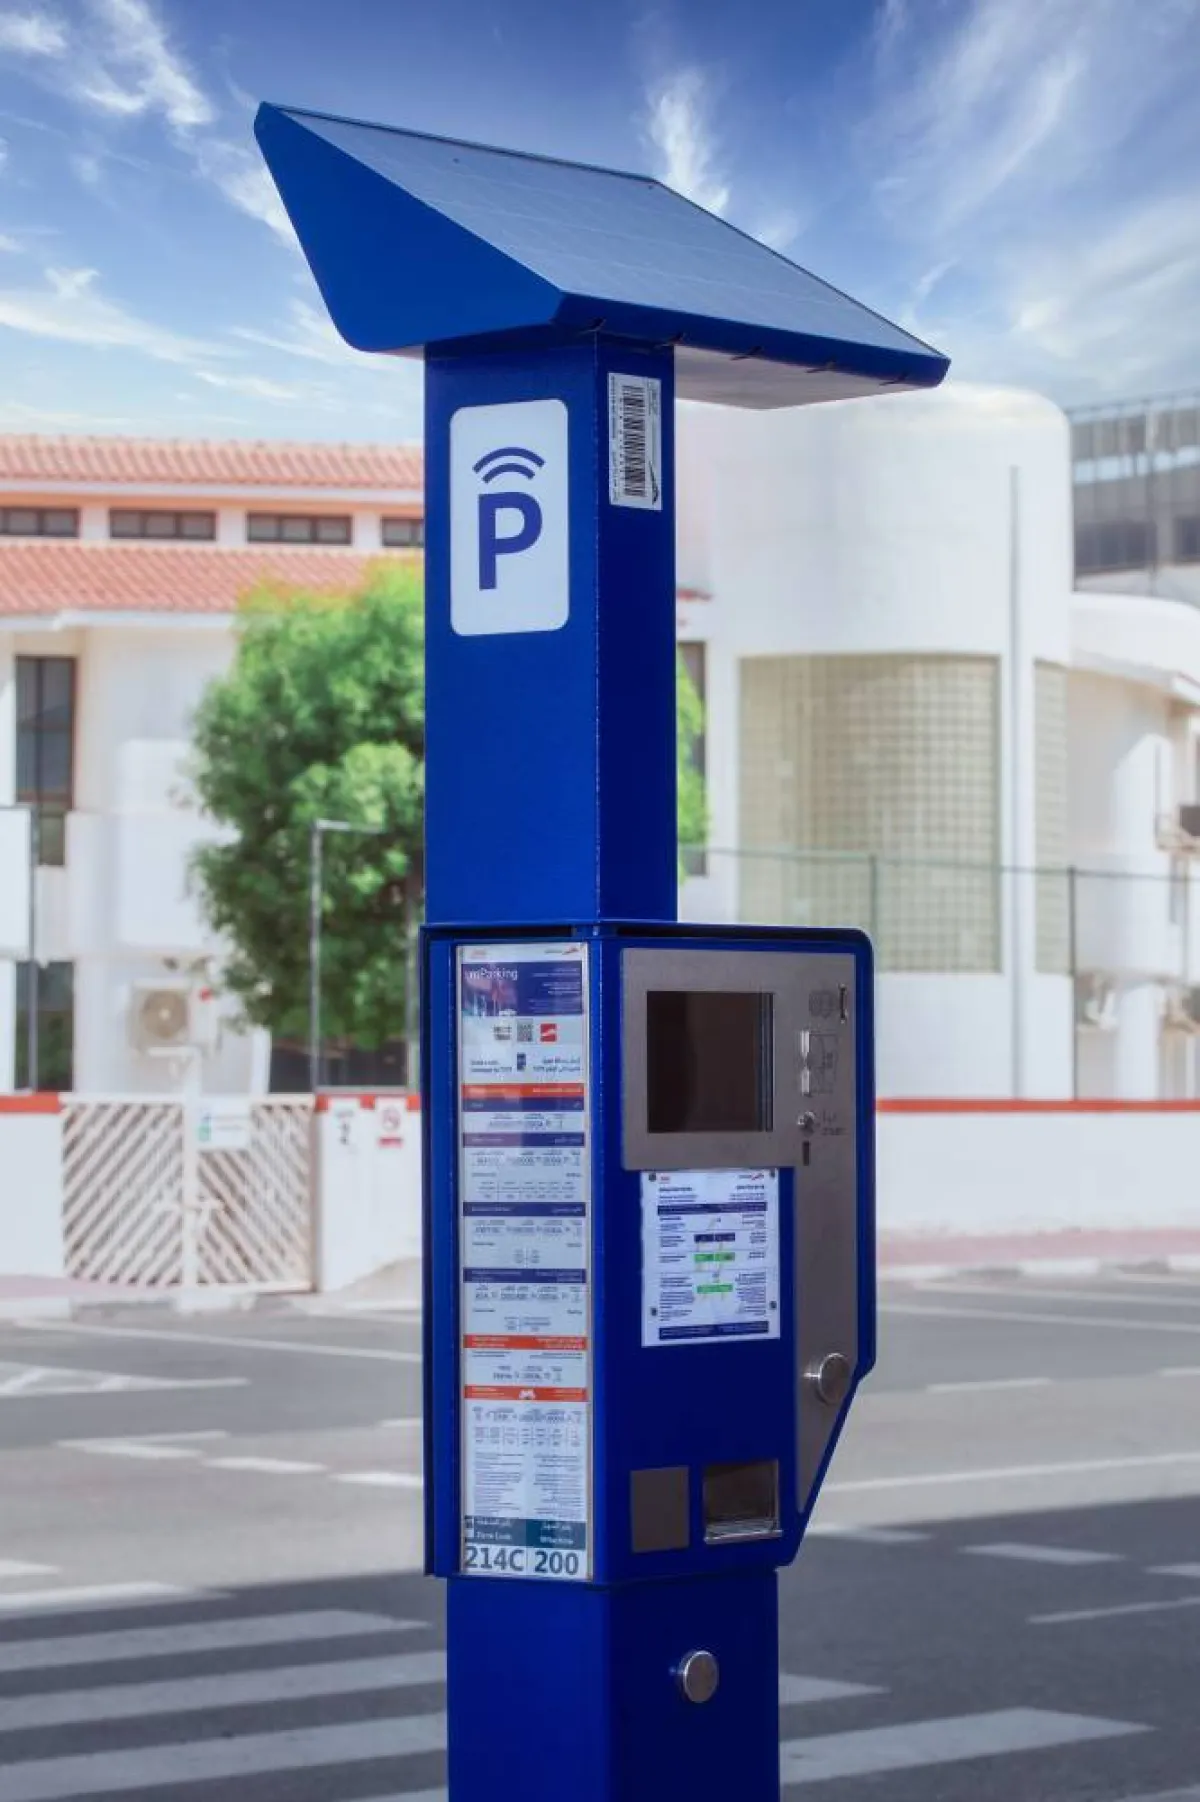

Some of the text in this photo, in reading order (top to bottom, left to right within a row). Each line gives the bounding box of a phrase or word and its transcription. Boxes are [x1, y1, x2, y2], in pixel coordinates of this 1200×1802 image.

[478, 491, 542, 590] P
[465, 1546, 524, 1571] 214C
[535, 1550, 579, 1575] 200
